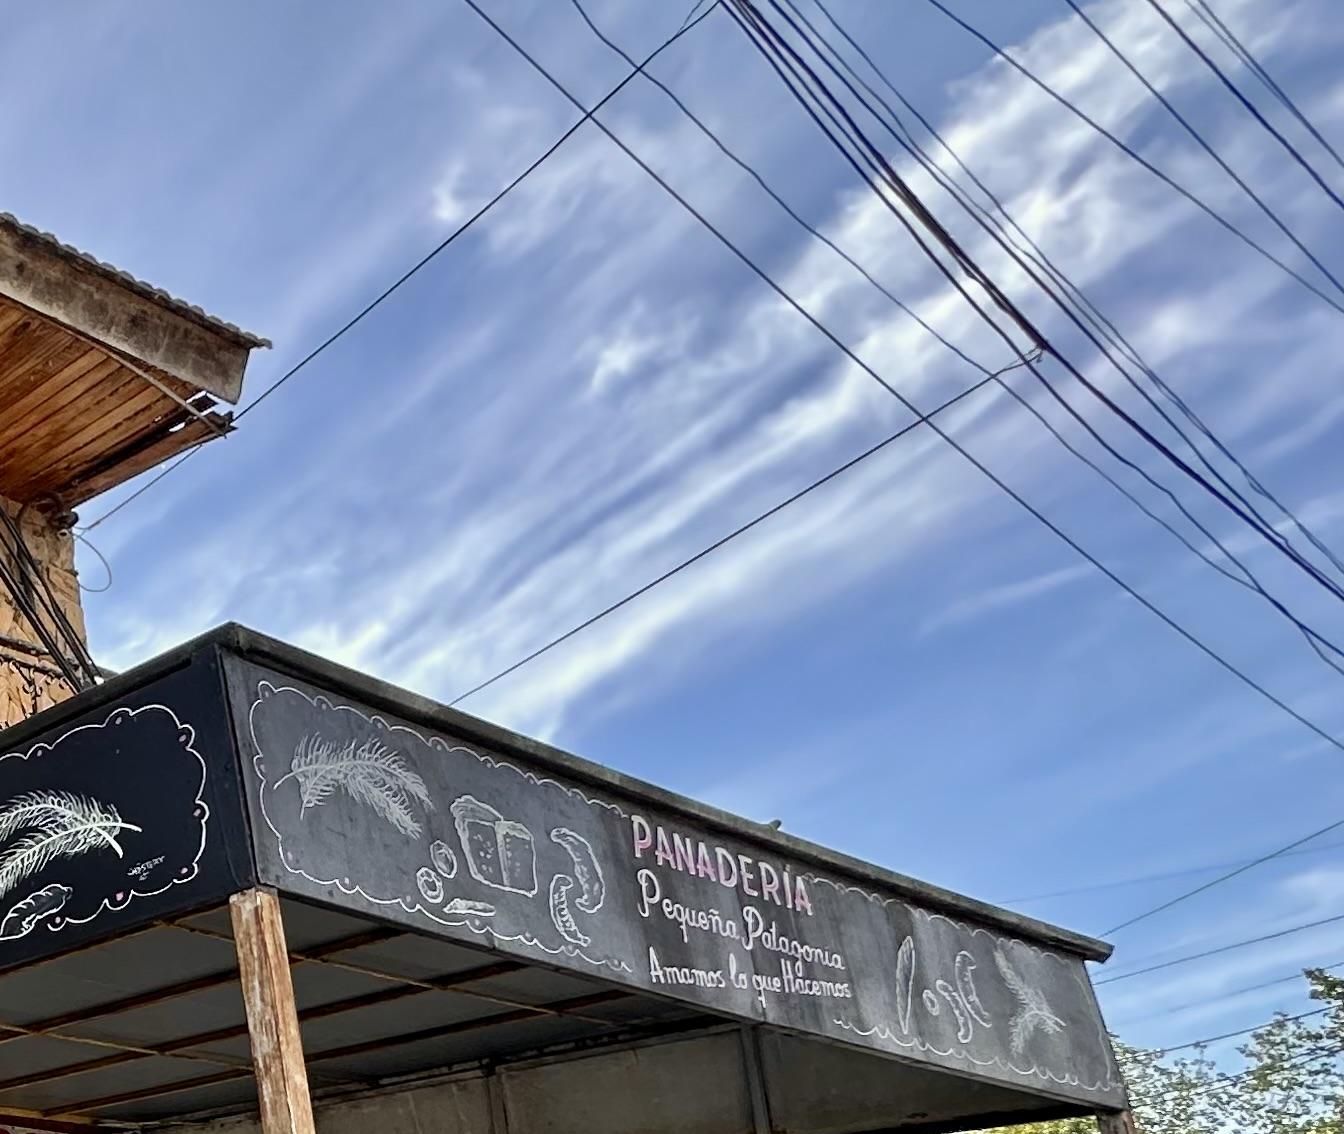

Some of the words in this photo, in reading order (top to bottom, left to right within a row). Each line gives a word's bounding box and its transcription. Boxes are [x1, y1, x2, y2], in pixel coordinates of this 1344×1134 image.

[631, 814, 813, 916] PANADERÍA
[637, 868, 737, 943] Pequeña
[741, 905, 845, 976] Patagonia
[649, 946, 725, 988] Amamos
[728, 953, 748, 989] lo
[752, 972, 782, 1008] que
[781, 958, 852, 998] Hacemos
